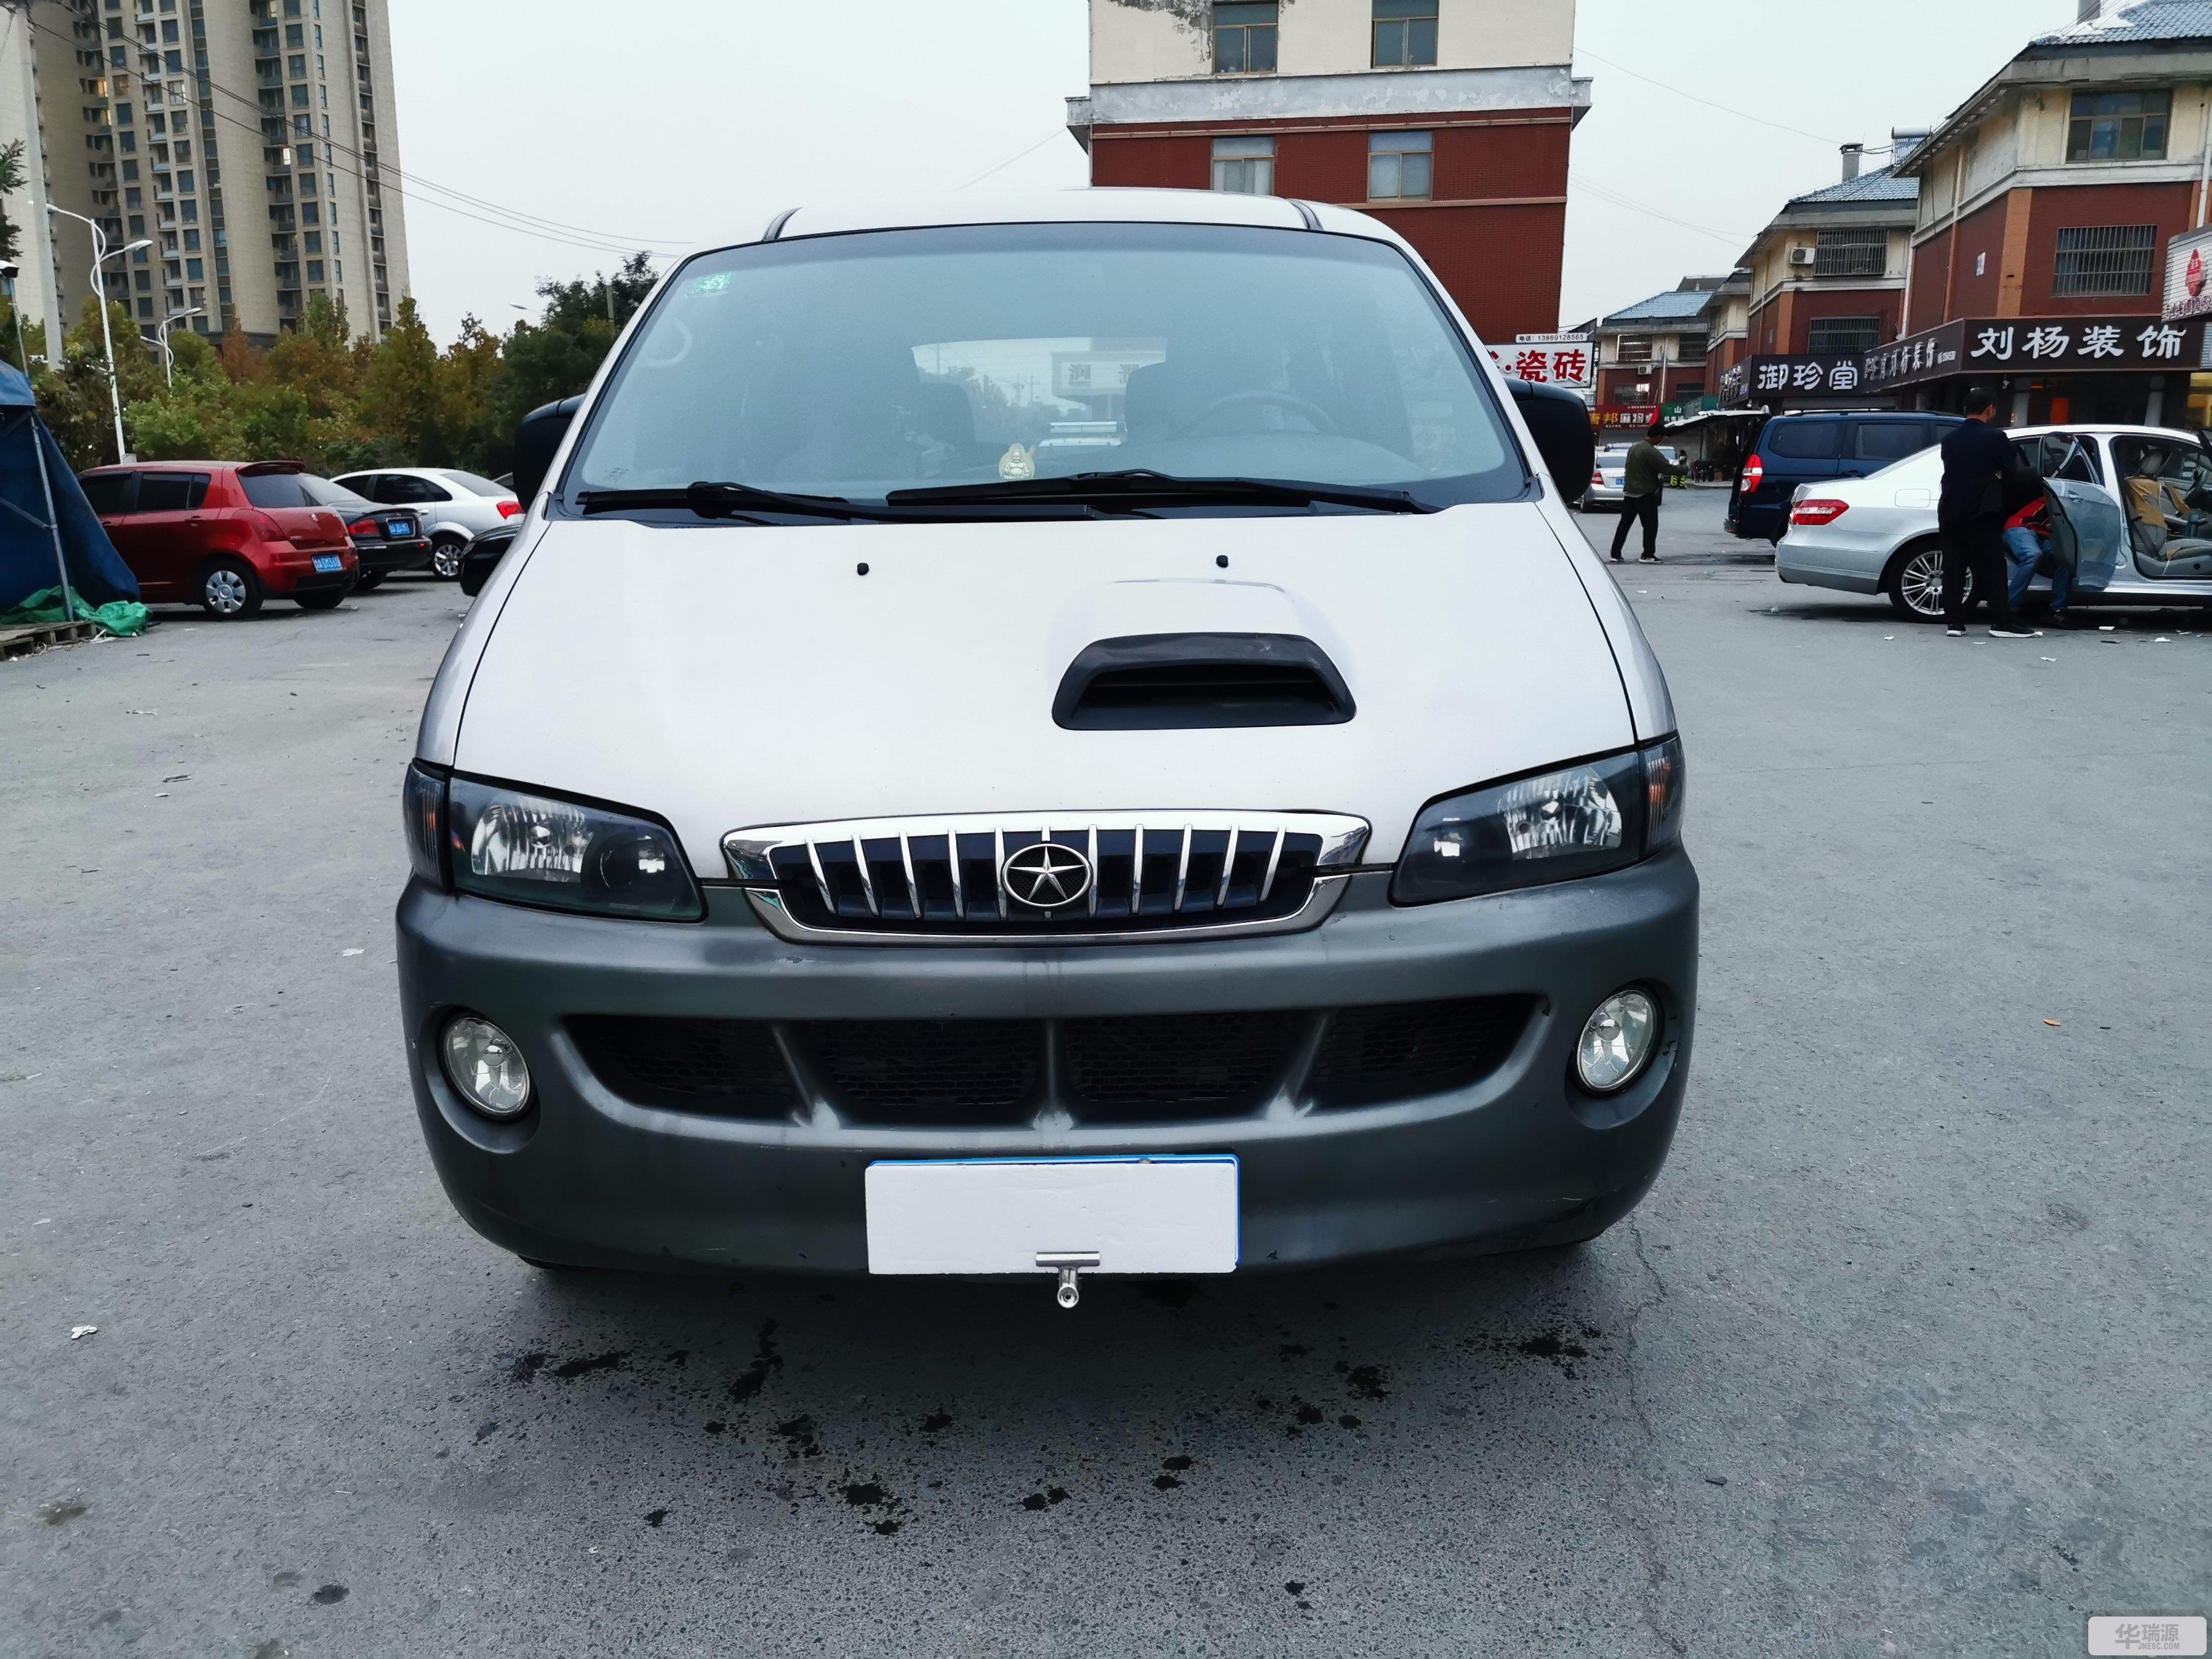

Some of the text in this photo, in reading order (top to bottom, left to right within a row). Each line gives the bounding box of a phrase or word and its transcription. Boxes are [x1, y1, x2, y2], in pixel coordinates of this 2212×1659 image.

[1970, 324, 2187, 360] 刘杨装饰
[1490, 349, 1587, 383] ·瓷砖
[1757, 360, 1858, 390] 御珍堂
